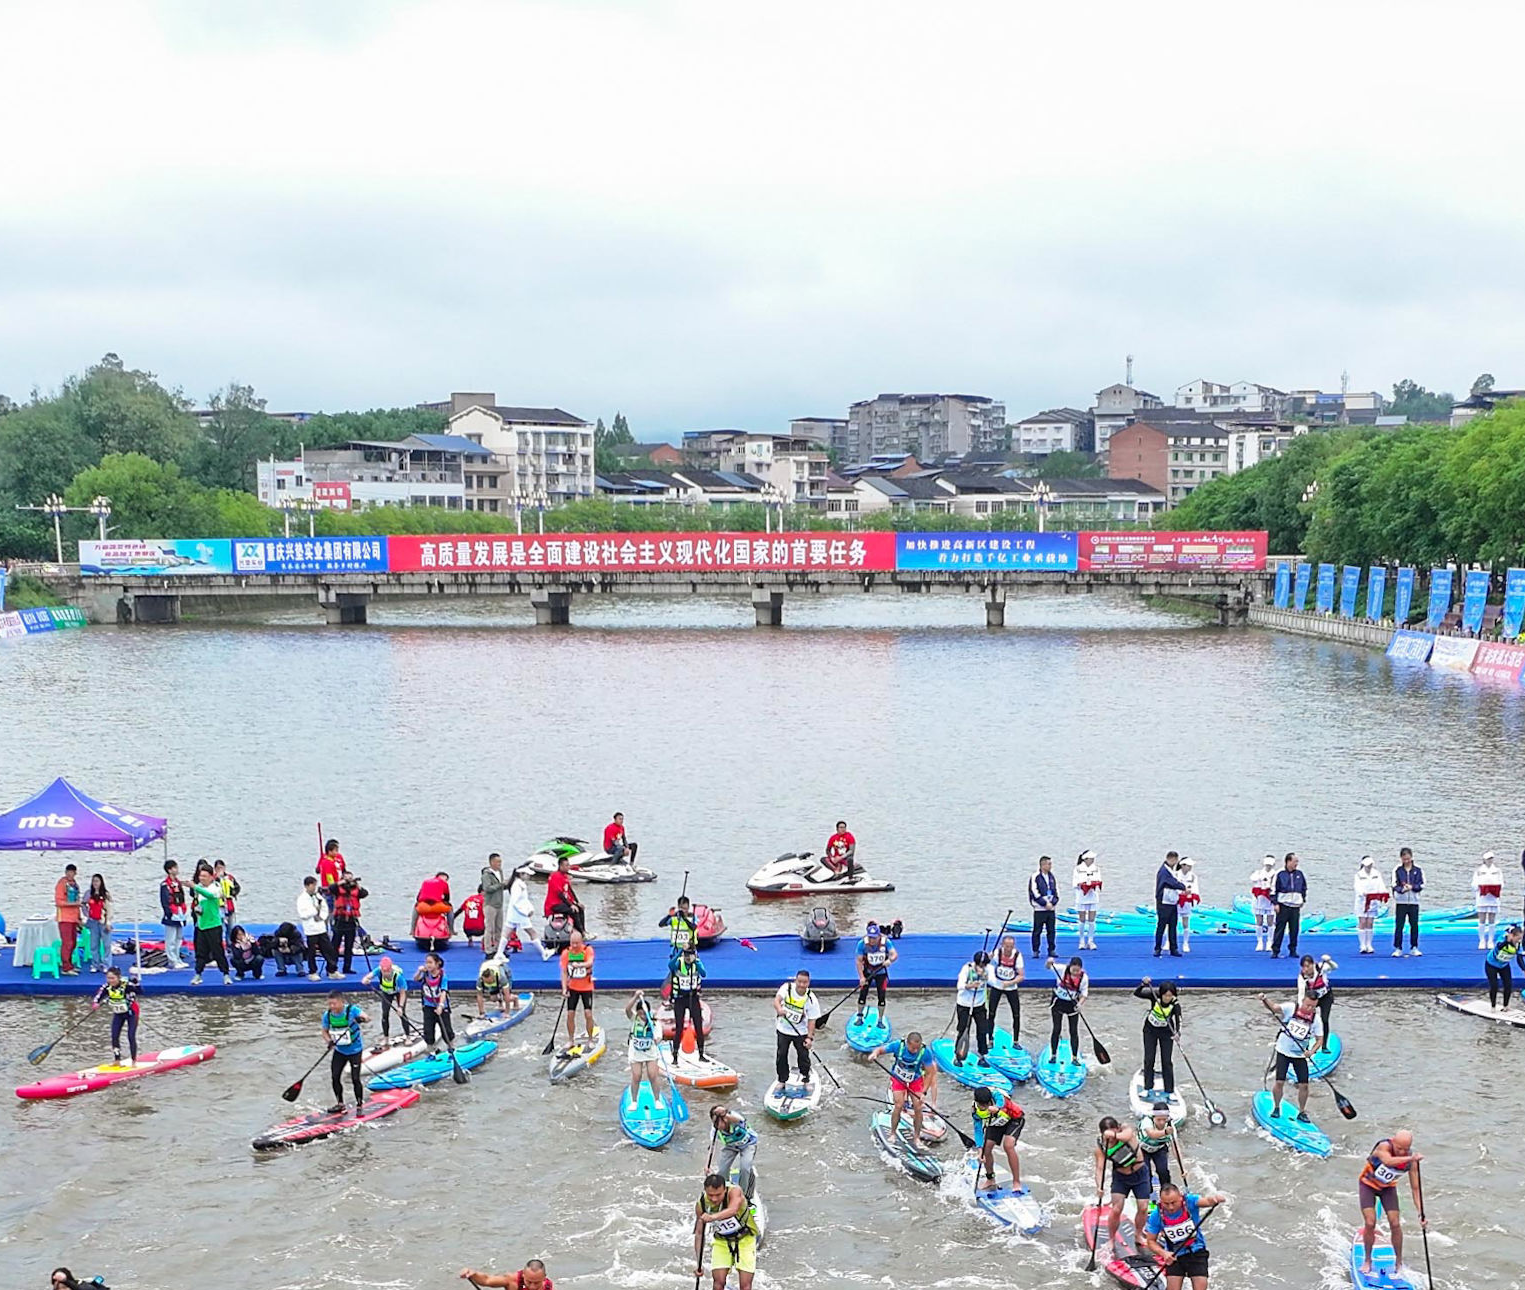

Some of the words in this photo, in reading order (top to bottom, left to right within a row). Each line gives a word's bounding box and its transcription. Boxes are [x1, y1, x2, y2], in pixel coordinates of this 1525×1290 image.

[266, 541, 381, 562] 重庆兴垫实业集团有限公司
[906, 539, 1036, 550] 加快推进高新区建设工程
[419, 539, 867, 567] 高质量发展是全面建设社会主义现代化国家的首要任务
[18, 812, 75, 829] mts
[786, 1012, 799, 1021] 78
[1377, 1167, 1394, 1180] 30
[1166, 1225, 1194, 1239] 366
